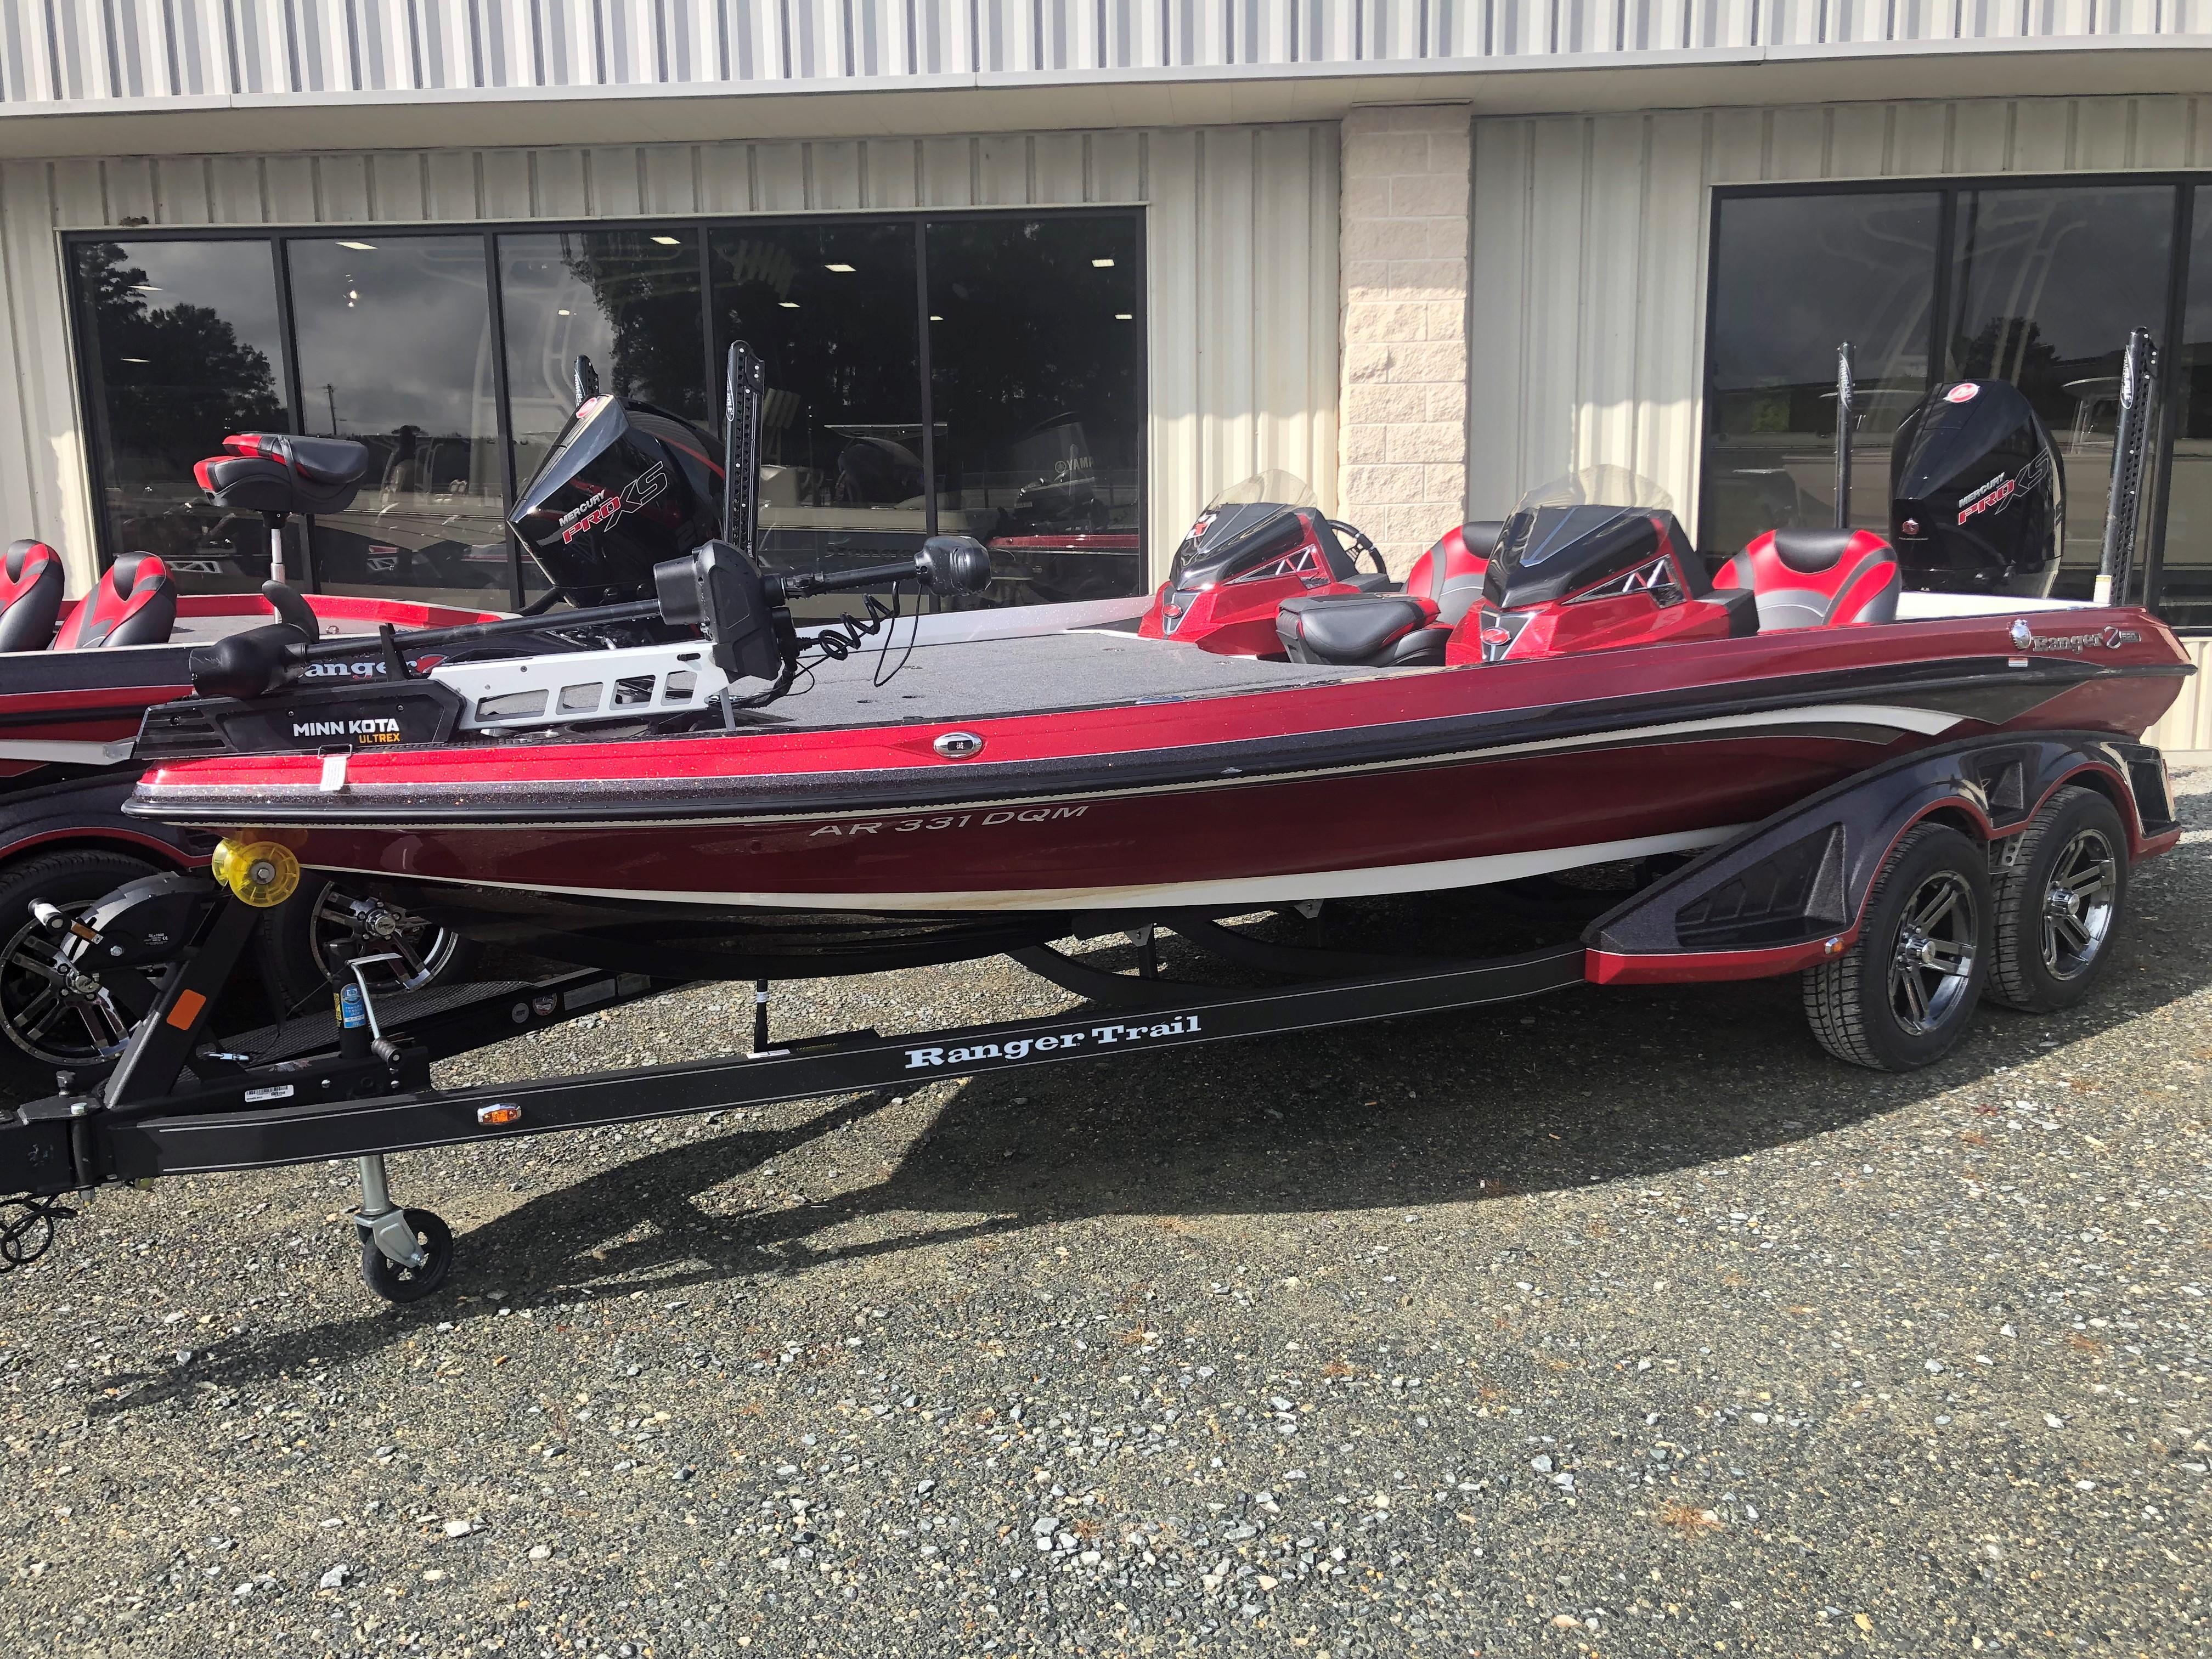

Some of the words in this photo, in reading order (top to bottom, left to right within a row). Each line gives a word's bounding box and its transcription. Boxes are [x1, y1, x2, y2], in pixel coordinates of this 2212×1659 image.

[1959, 472, 2005, 508] MERCURY
[558, 489, 605, 527] MERCURY
[2032, 633, 2103, 654] Ranger
[293, 721, 345, 737] MINN
[349, 718, 399, 733] KOTA
[359, 733, 400, 744] ULTREX
[809, 822, 883, 836] AR
[895, 815, 972, 832] 331
[981, 806, 1089, 826] DQM
[905, 1032, 1085, 1069] Ranger
[1091, 1015, 1201, 1045] Trail
